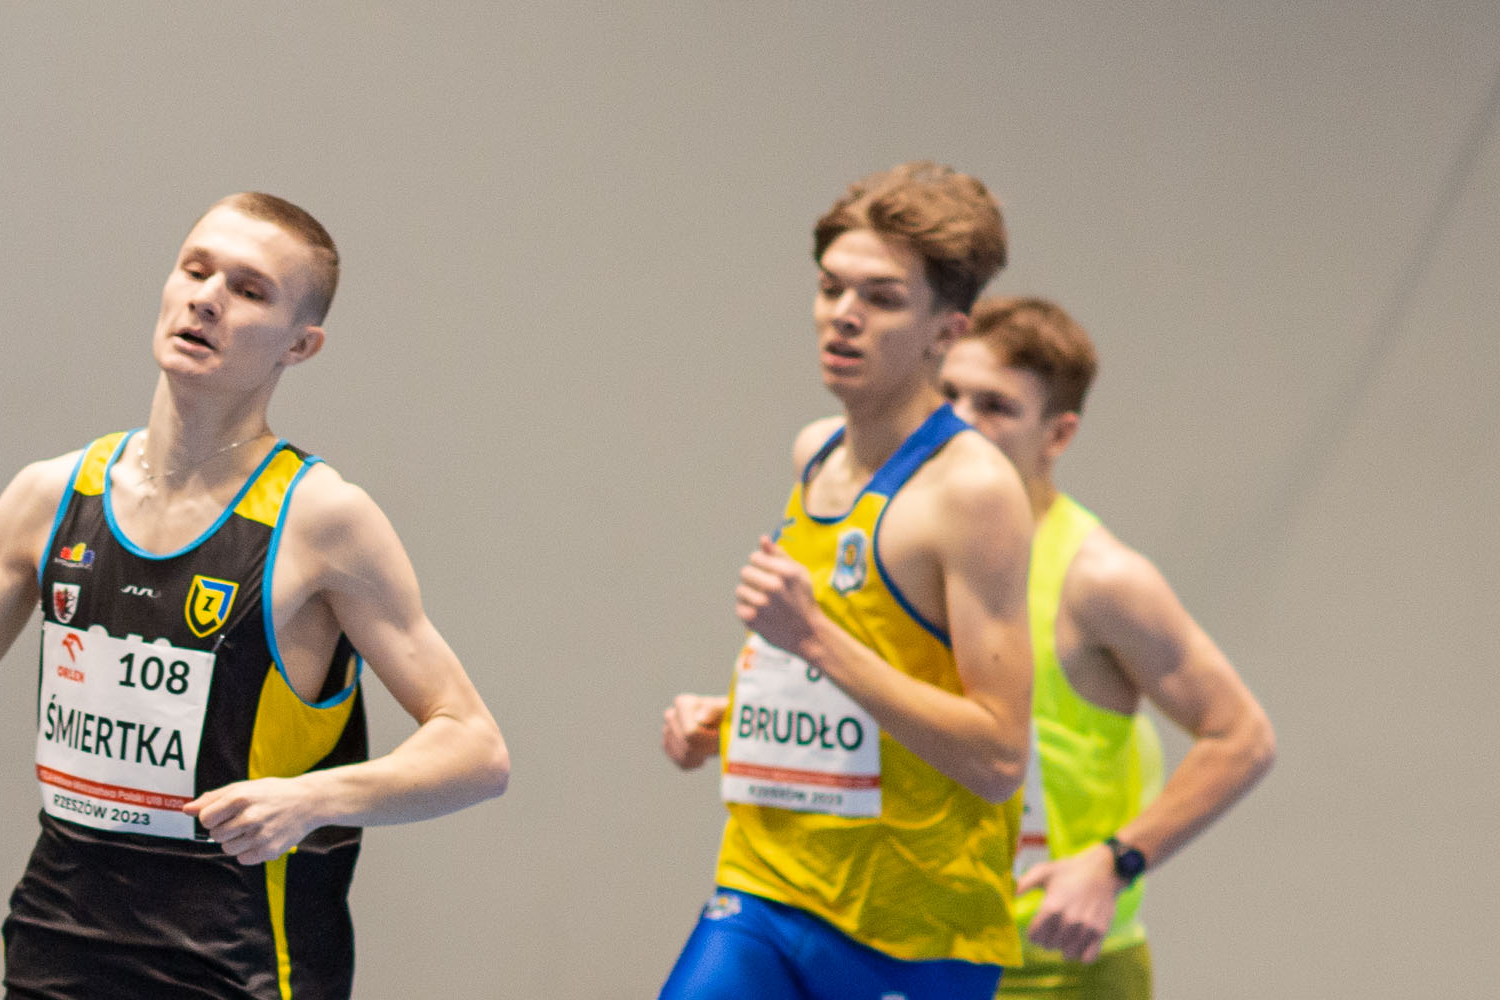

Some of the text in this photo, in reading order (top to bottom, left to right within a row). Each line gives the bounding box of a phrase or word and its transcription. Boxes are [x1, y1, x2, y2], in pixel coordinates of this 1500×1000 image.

[118, 652, 190, 695] 108
[45, 694, 186, 771] ŚMIERTKA
[738, 704, 864, 751] BRUDŁO
[53, 793, 151, 826] RZESZÓW 2023
